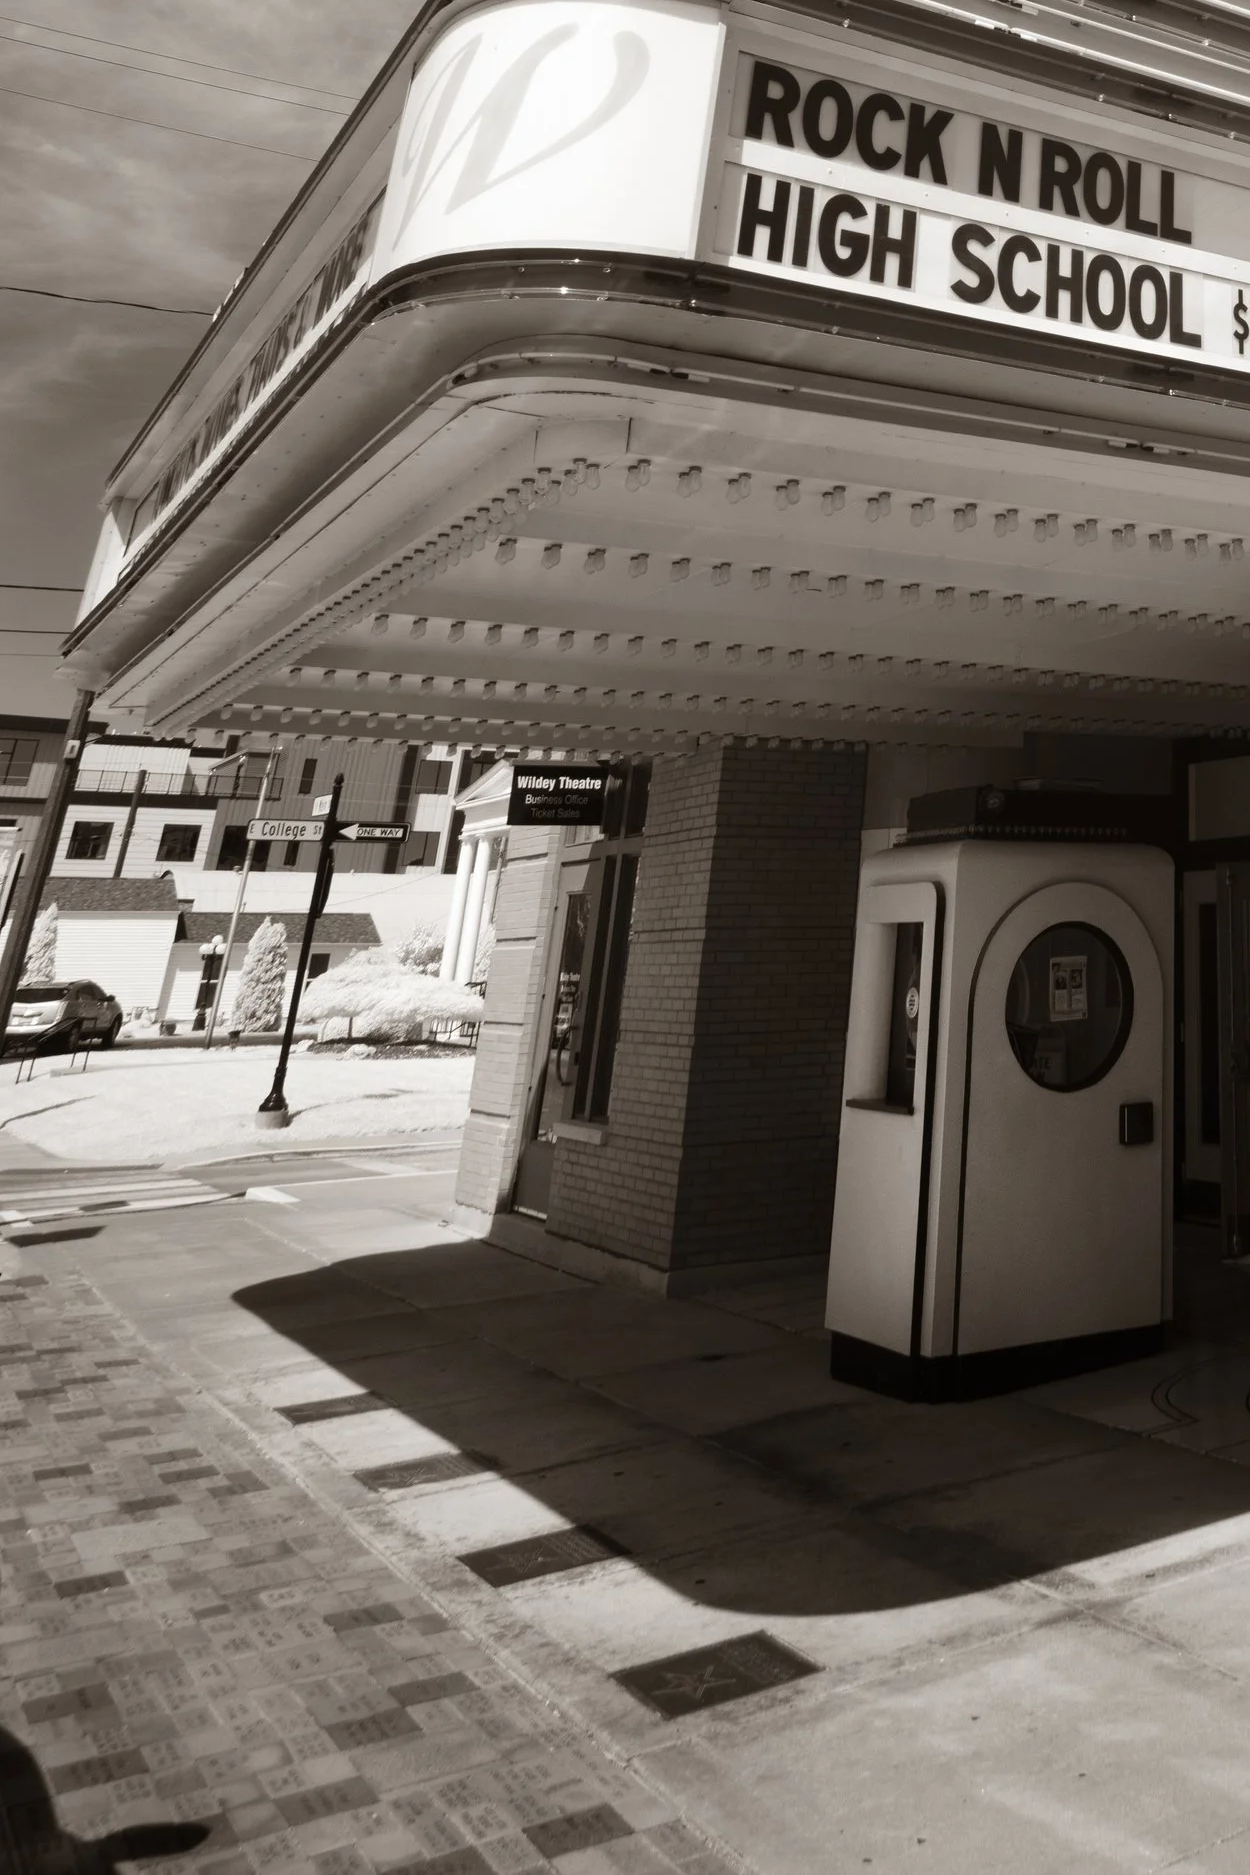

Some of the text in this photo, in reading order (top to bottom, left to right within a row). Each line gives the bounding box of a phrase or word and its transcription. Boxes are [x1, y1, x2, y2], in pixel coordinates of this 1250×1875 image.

[745, 60, 954, 186] ROCK
[978, 121, 1024, 203] N
[1038, 137, 1192, 245] ROLL
[737, 172, 918, 289] HIGH
[950, 222, 1202, 349] SCHOOL
[517, 775, 602, 792] Wildey Theatre
[525, 793, 589, 805] Business Office
[530, 807, 581, 819] Ticket Sales
[261, 821, 307, 840] College
[312, 824, 323, 835] St
[356, 827, 401, 837] ONE WAY
